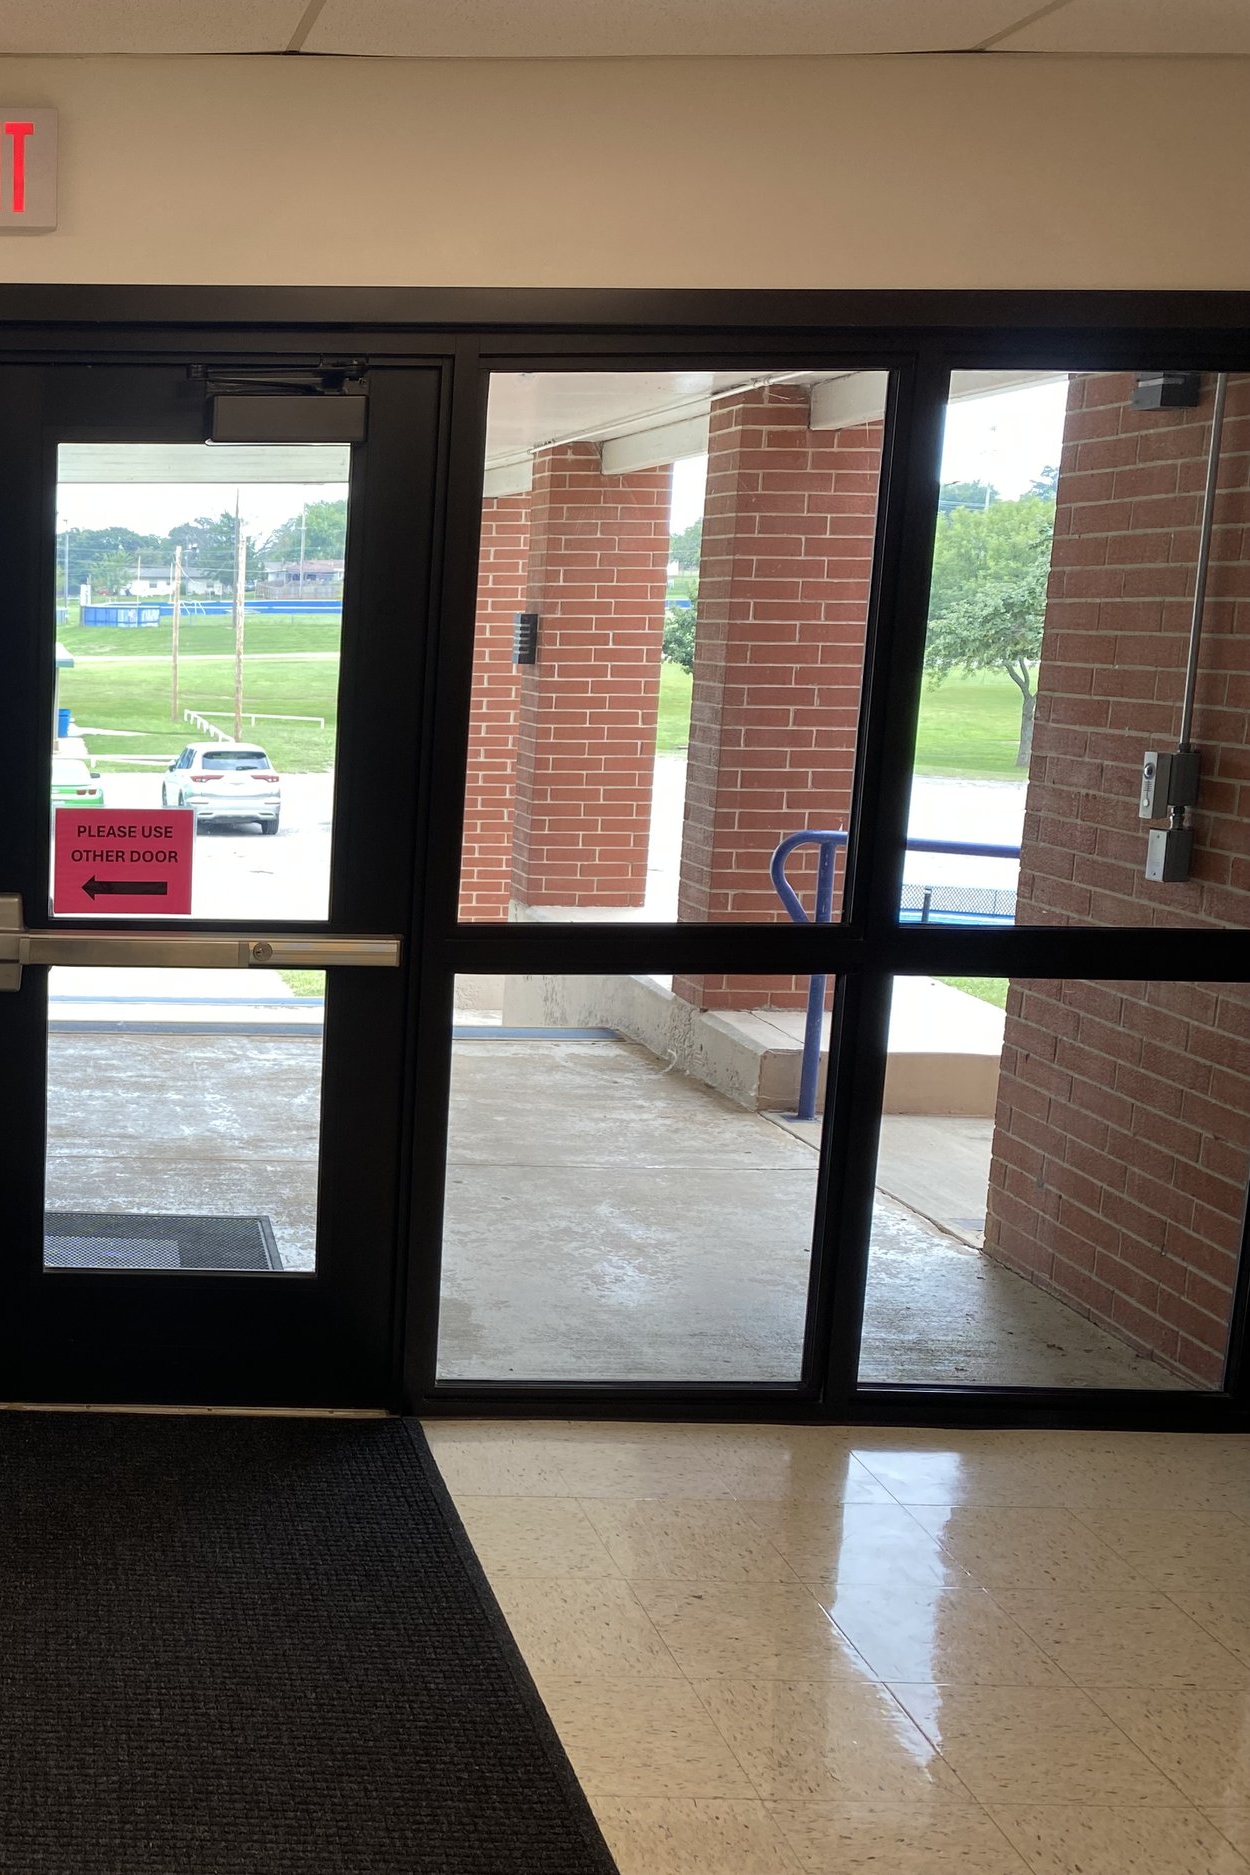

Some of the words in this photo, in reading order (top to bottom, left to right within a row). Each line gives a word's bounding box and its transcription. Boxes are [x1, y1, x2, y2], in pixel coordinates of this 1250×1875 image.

[78, 826, 136, 838] PLEASE
[142, 826, 173, 838] USE
[71, 850, 125, 862] OTHER
[130, 850, 178, 863] DOOR
